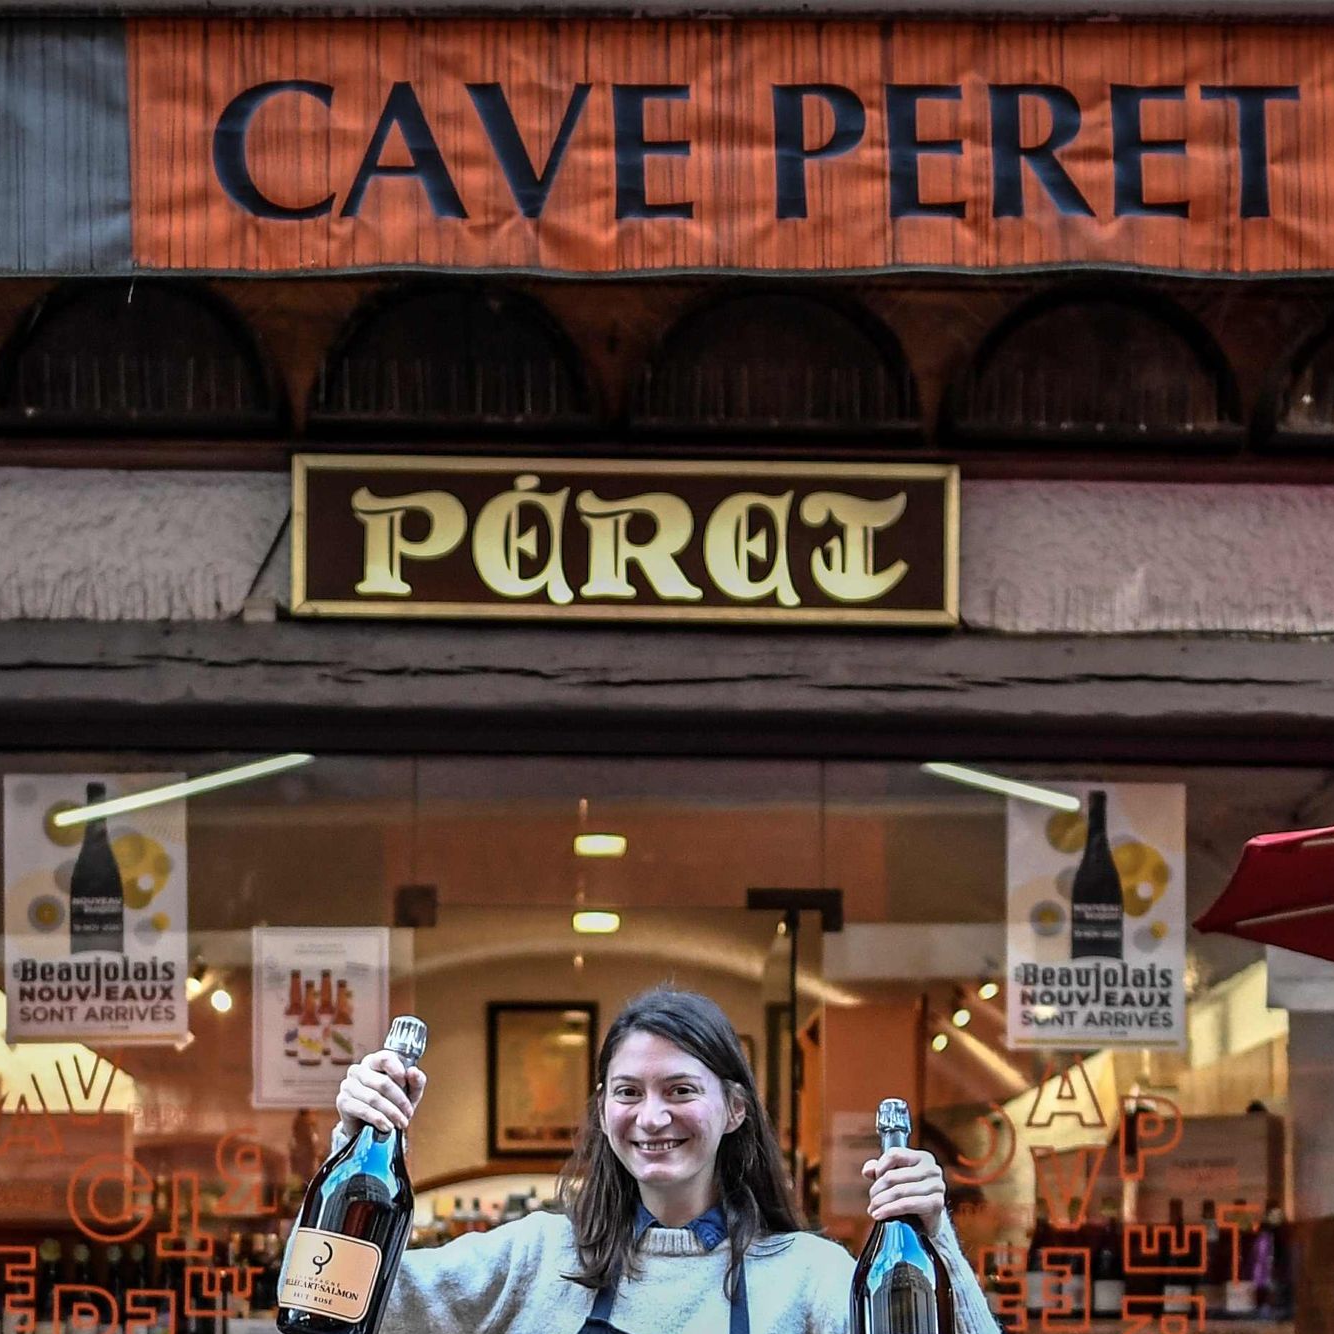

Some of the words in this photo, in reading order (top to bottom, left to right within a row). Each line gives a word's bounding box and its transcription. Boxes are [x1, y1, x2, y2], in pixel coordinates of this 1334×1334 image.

[213, 78, 695, 221] CAVE
[771, 81, 1300, 221] PERET
[20, 956, 176, 998] Beaujolais
[1021, 962, 1174, 1004] Beaujolais
[19, 1005, 77, 1023] SONT
[84, 1000, 176, 1023] ARRIVÉS
[1020, 1009, 1077, 1028] SONT
[1083, 1005, 1174, 1028] ARRIVÉS
